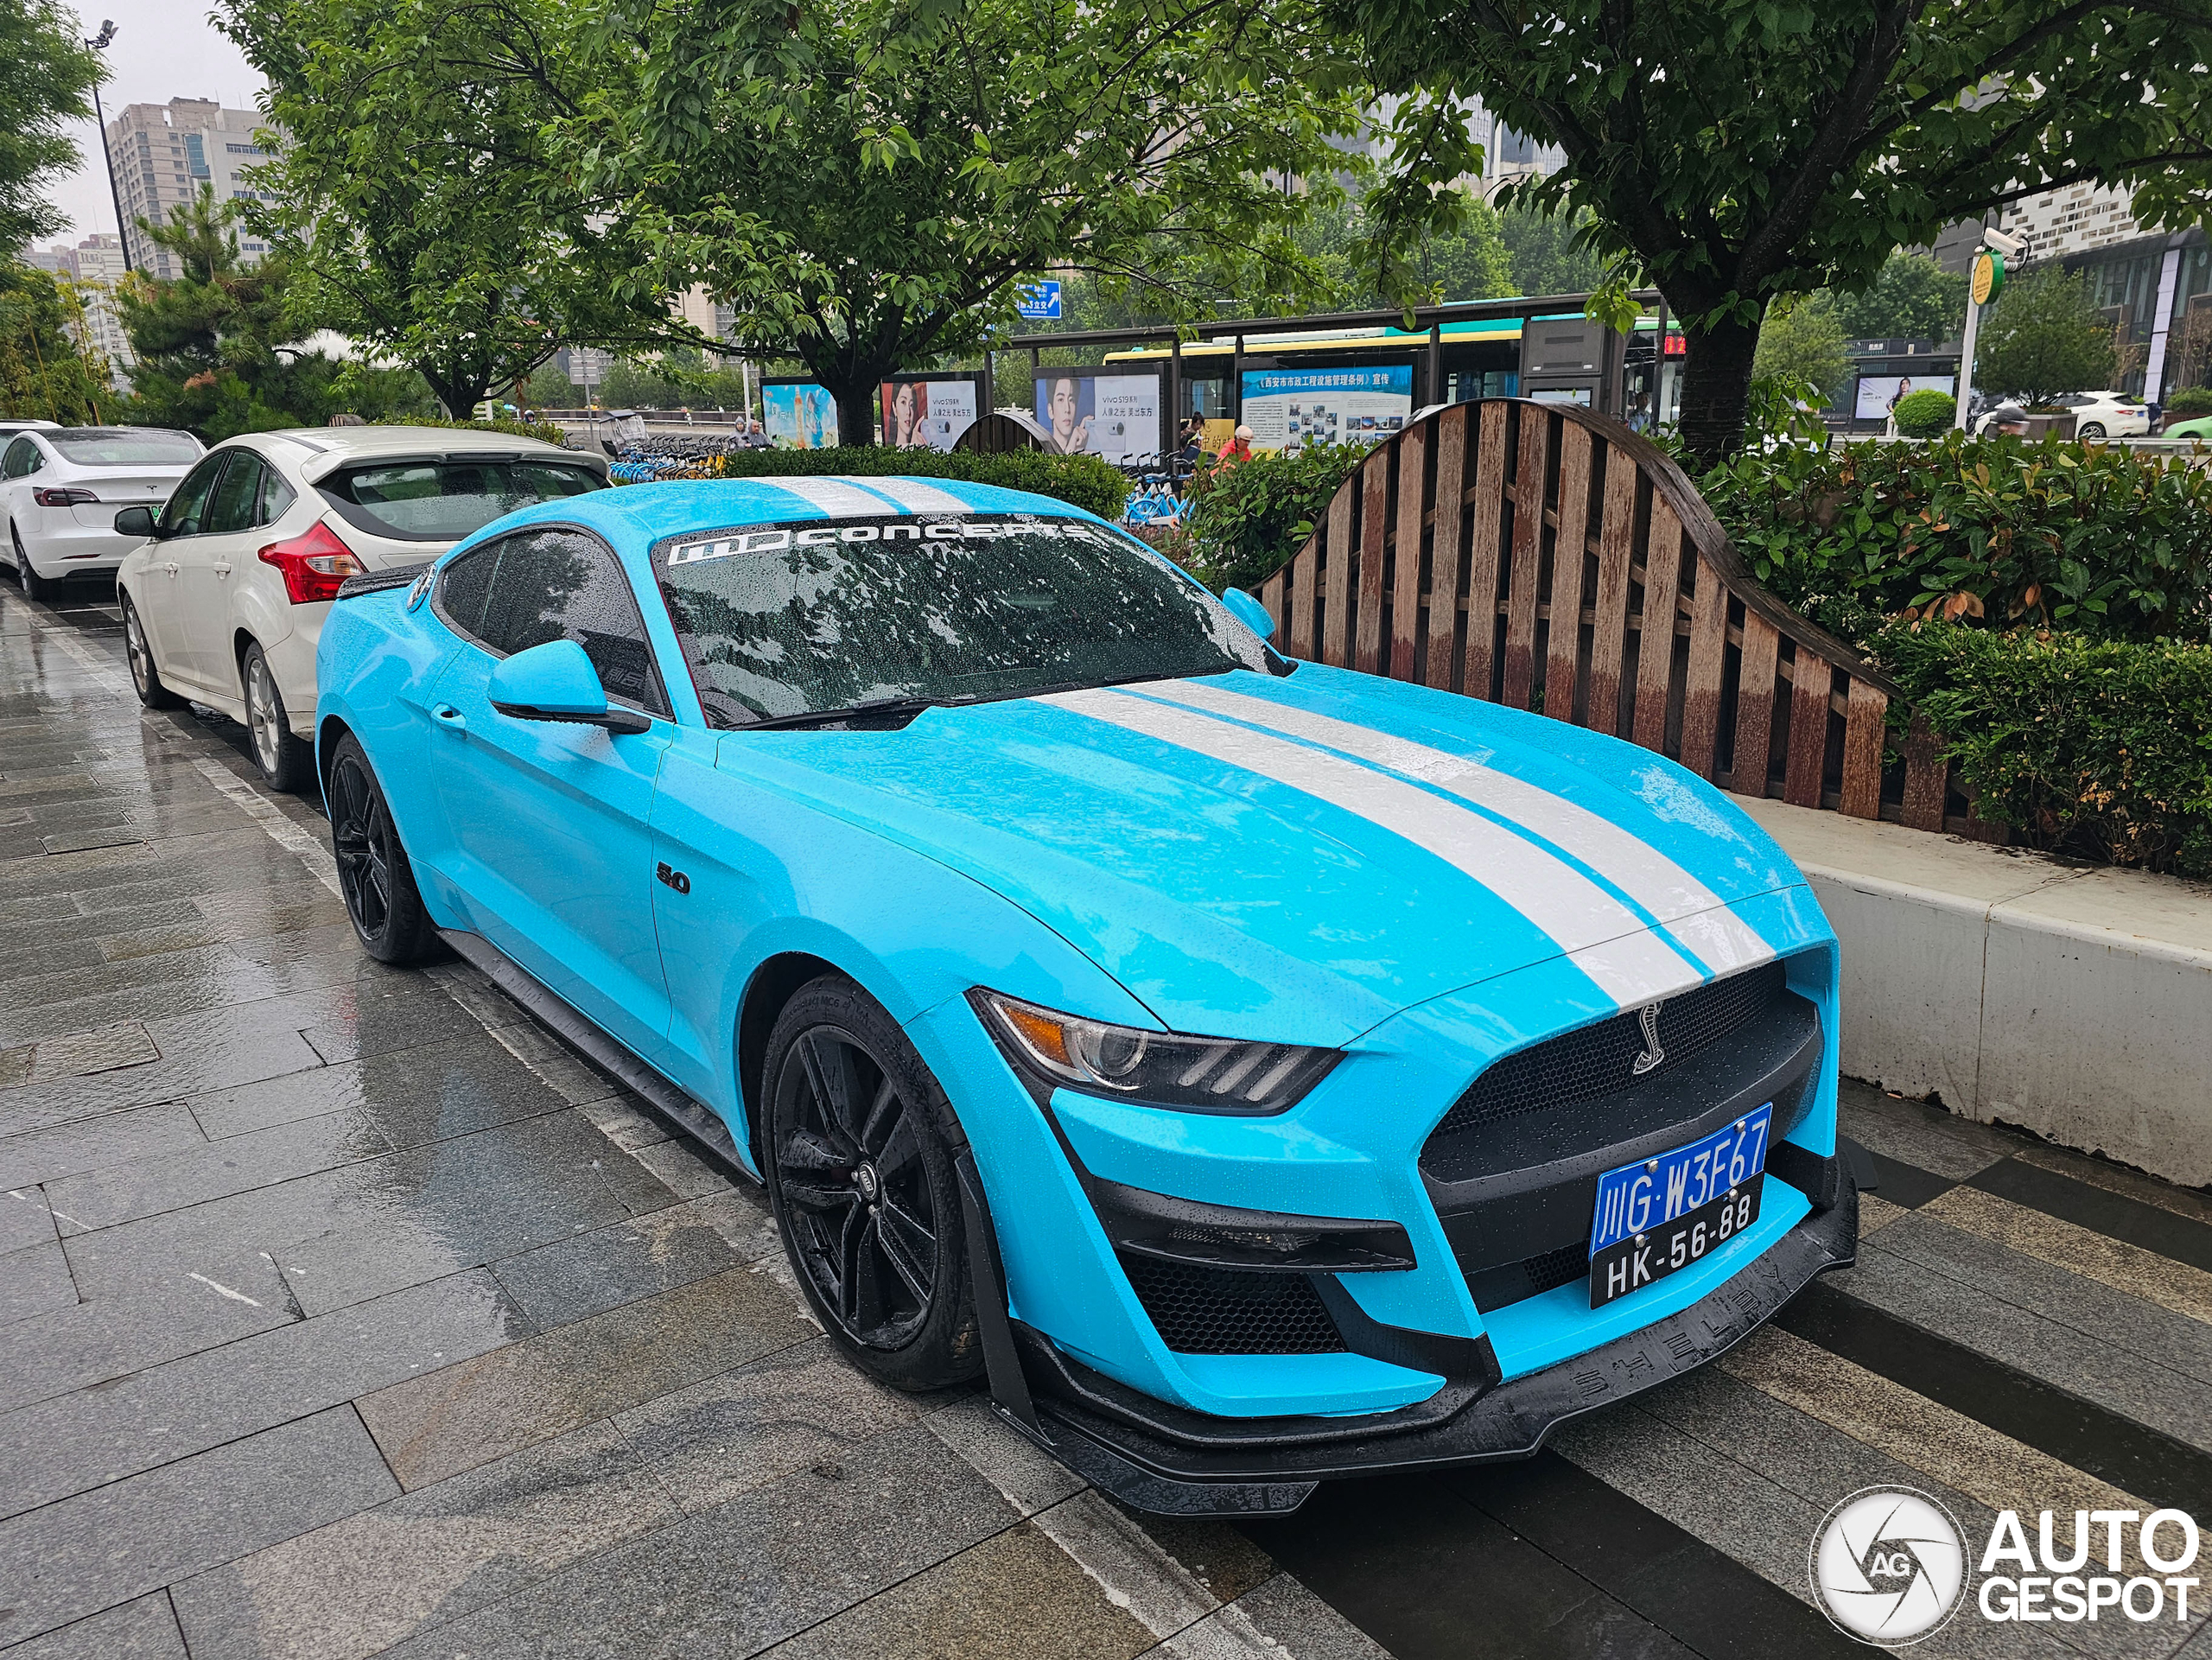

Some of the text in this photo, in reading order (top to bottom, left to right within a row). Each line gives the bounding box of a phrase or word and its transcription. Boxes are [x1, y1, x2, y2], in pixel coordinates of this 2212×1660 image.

[656, 861, 691, 895] 5.0
[1607, 1194, 1751, 1299] HK-56-88
[1572, 1264, 1795, 1398] SHELBY
